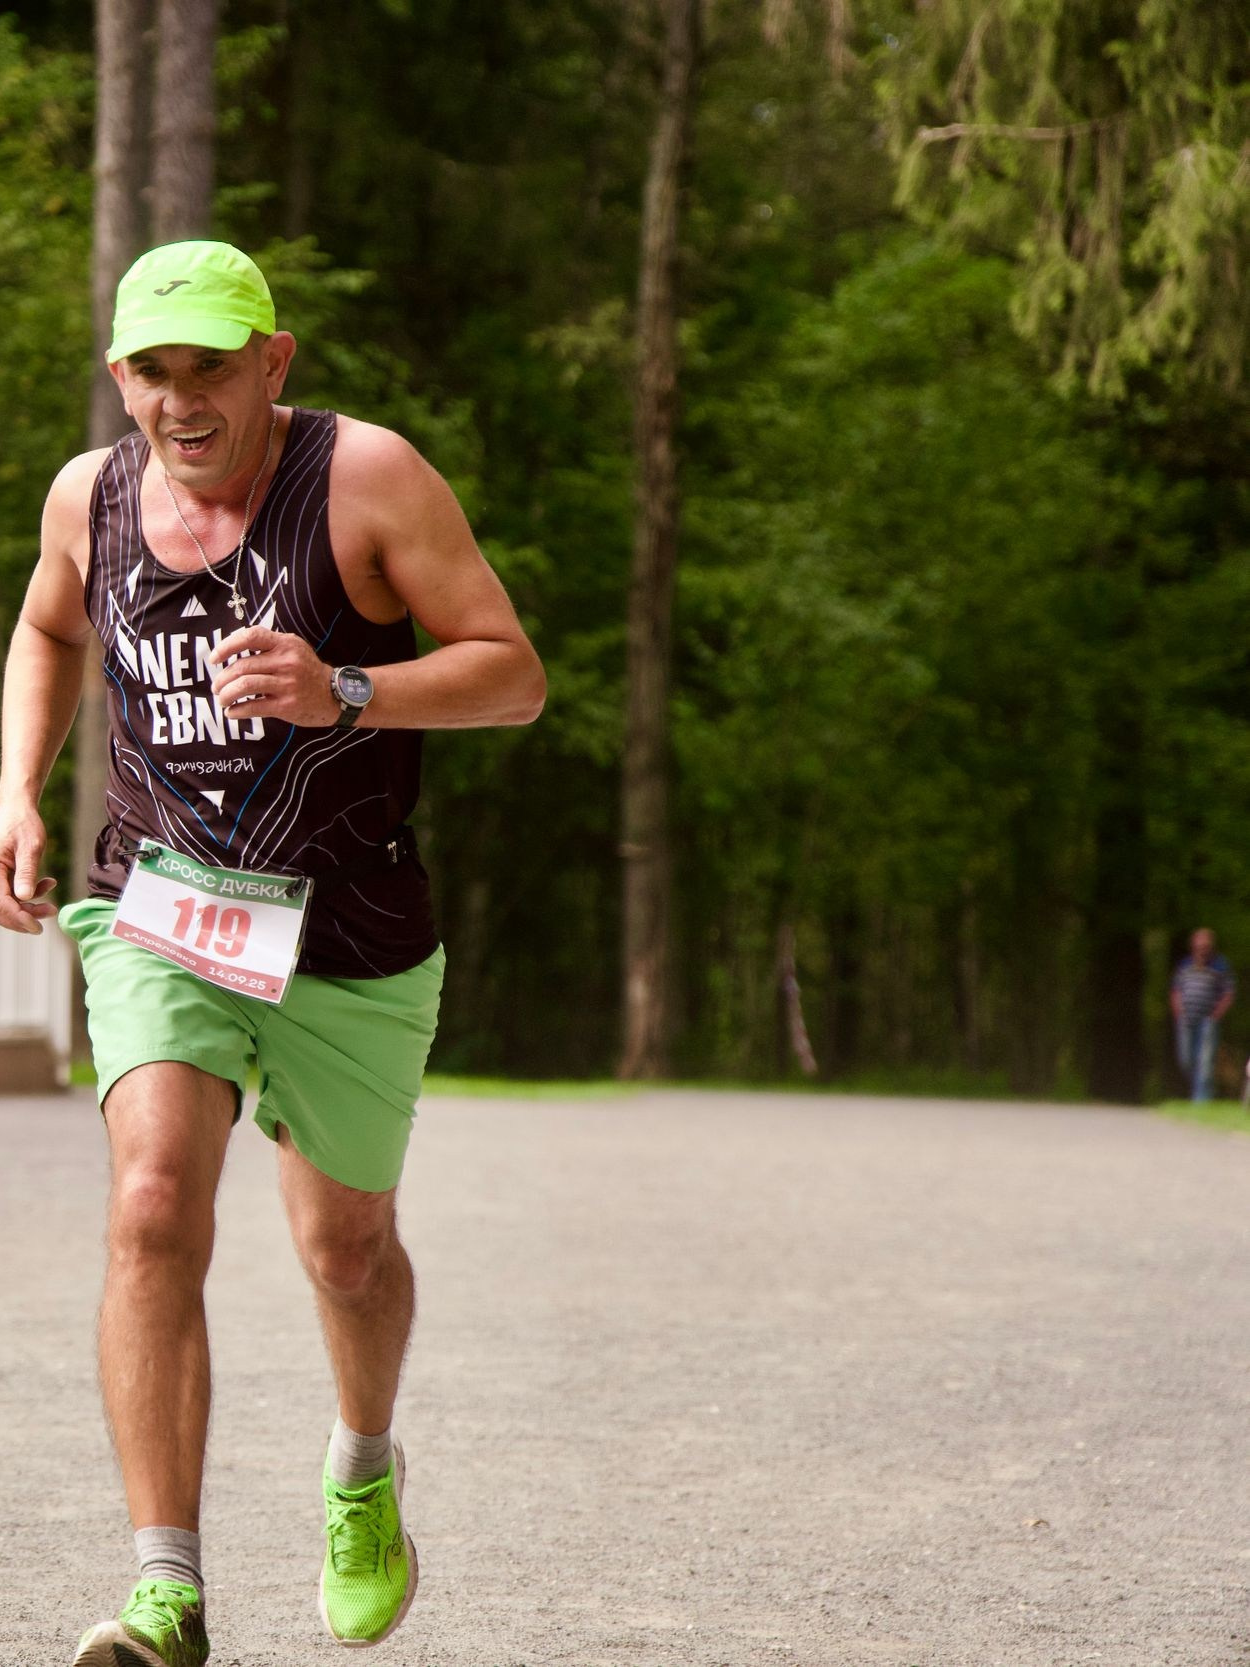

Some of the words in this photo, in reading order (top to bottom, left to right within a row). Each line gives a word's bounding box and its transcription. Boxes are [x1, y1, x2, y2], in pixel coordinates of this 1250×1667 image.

[156, 855, 217, 888] КРОСС
[219, 877, 288, 900] ДУБКИ
[171, 896, 252, 959] 119
[208, 966, 267, 991] 14.09.25
